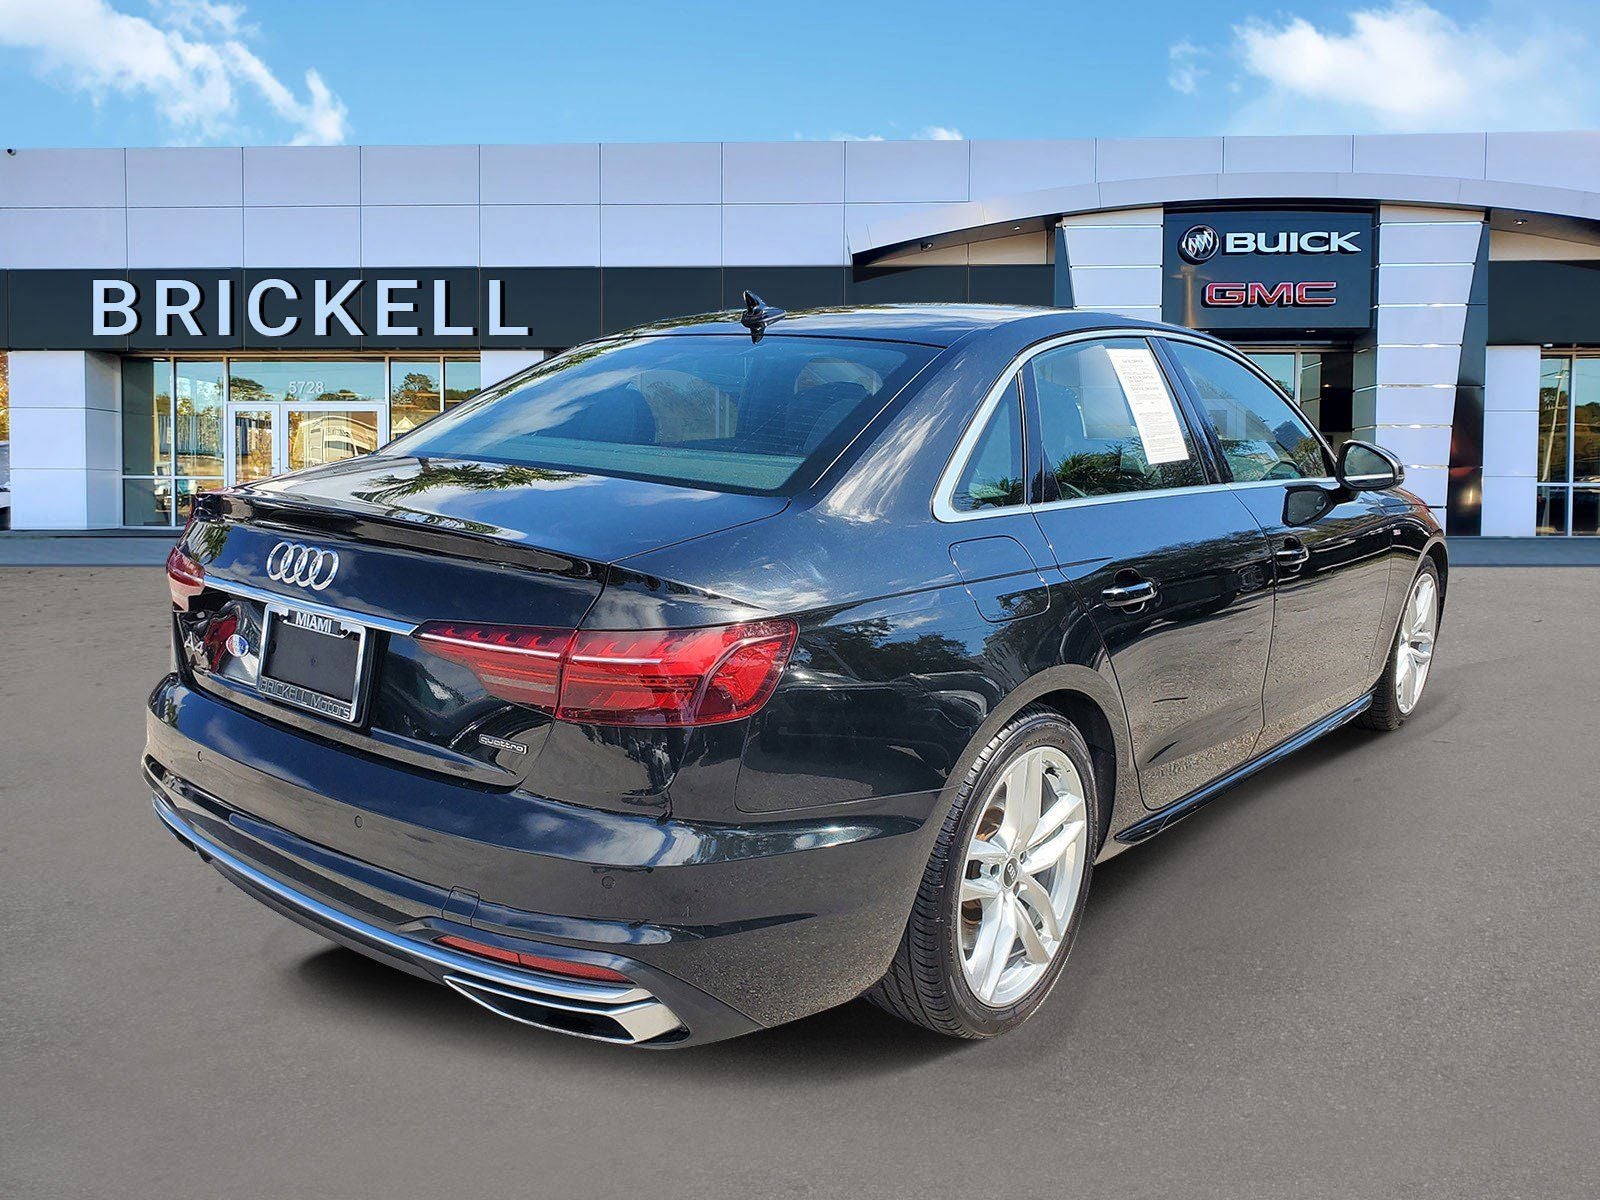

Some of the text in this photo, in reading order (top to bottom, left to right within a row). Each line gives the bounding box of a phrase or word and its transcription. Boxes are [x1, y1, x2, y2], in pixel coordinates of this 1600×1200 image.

[1225, 230, 1362, 253] BUICK
[1205, 281, 1337, 306] GMC
[91, 278, 530, 337] BRICKELL
[288, 380, 325, 395] 5728
[295, 611, 333, 634] MIAMI
[260, 679, 308, 705] BRICKELL
[480, 736, 524, 752] quattro
